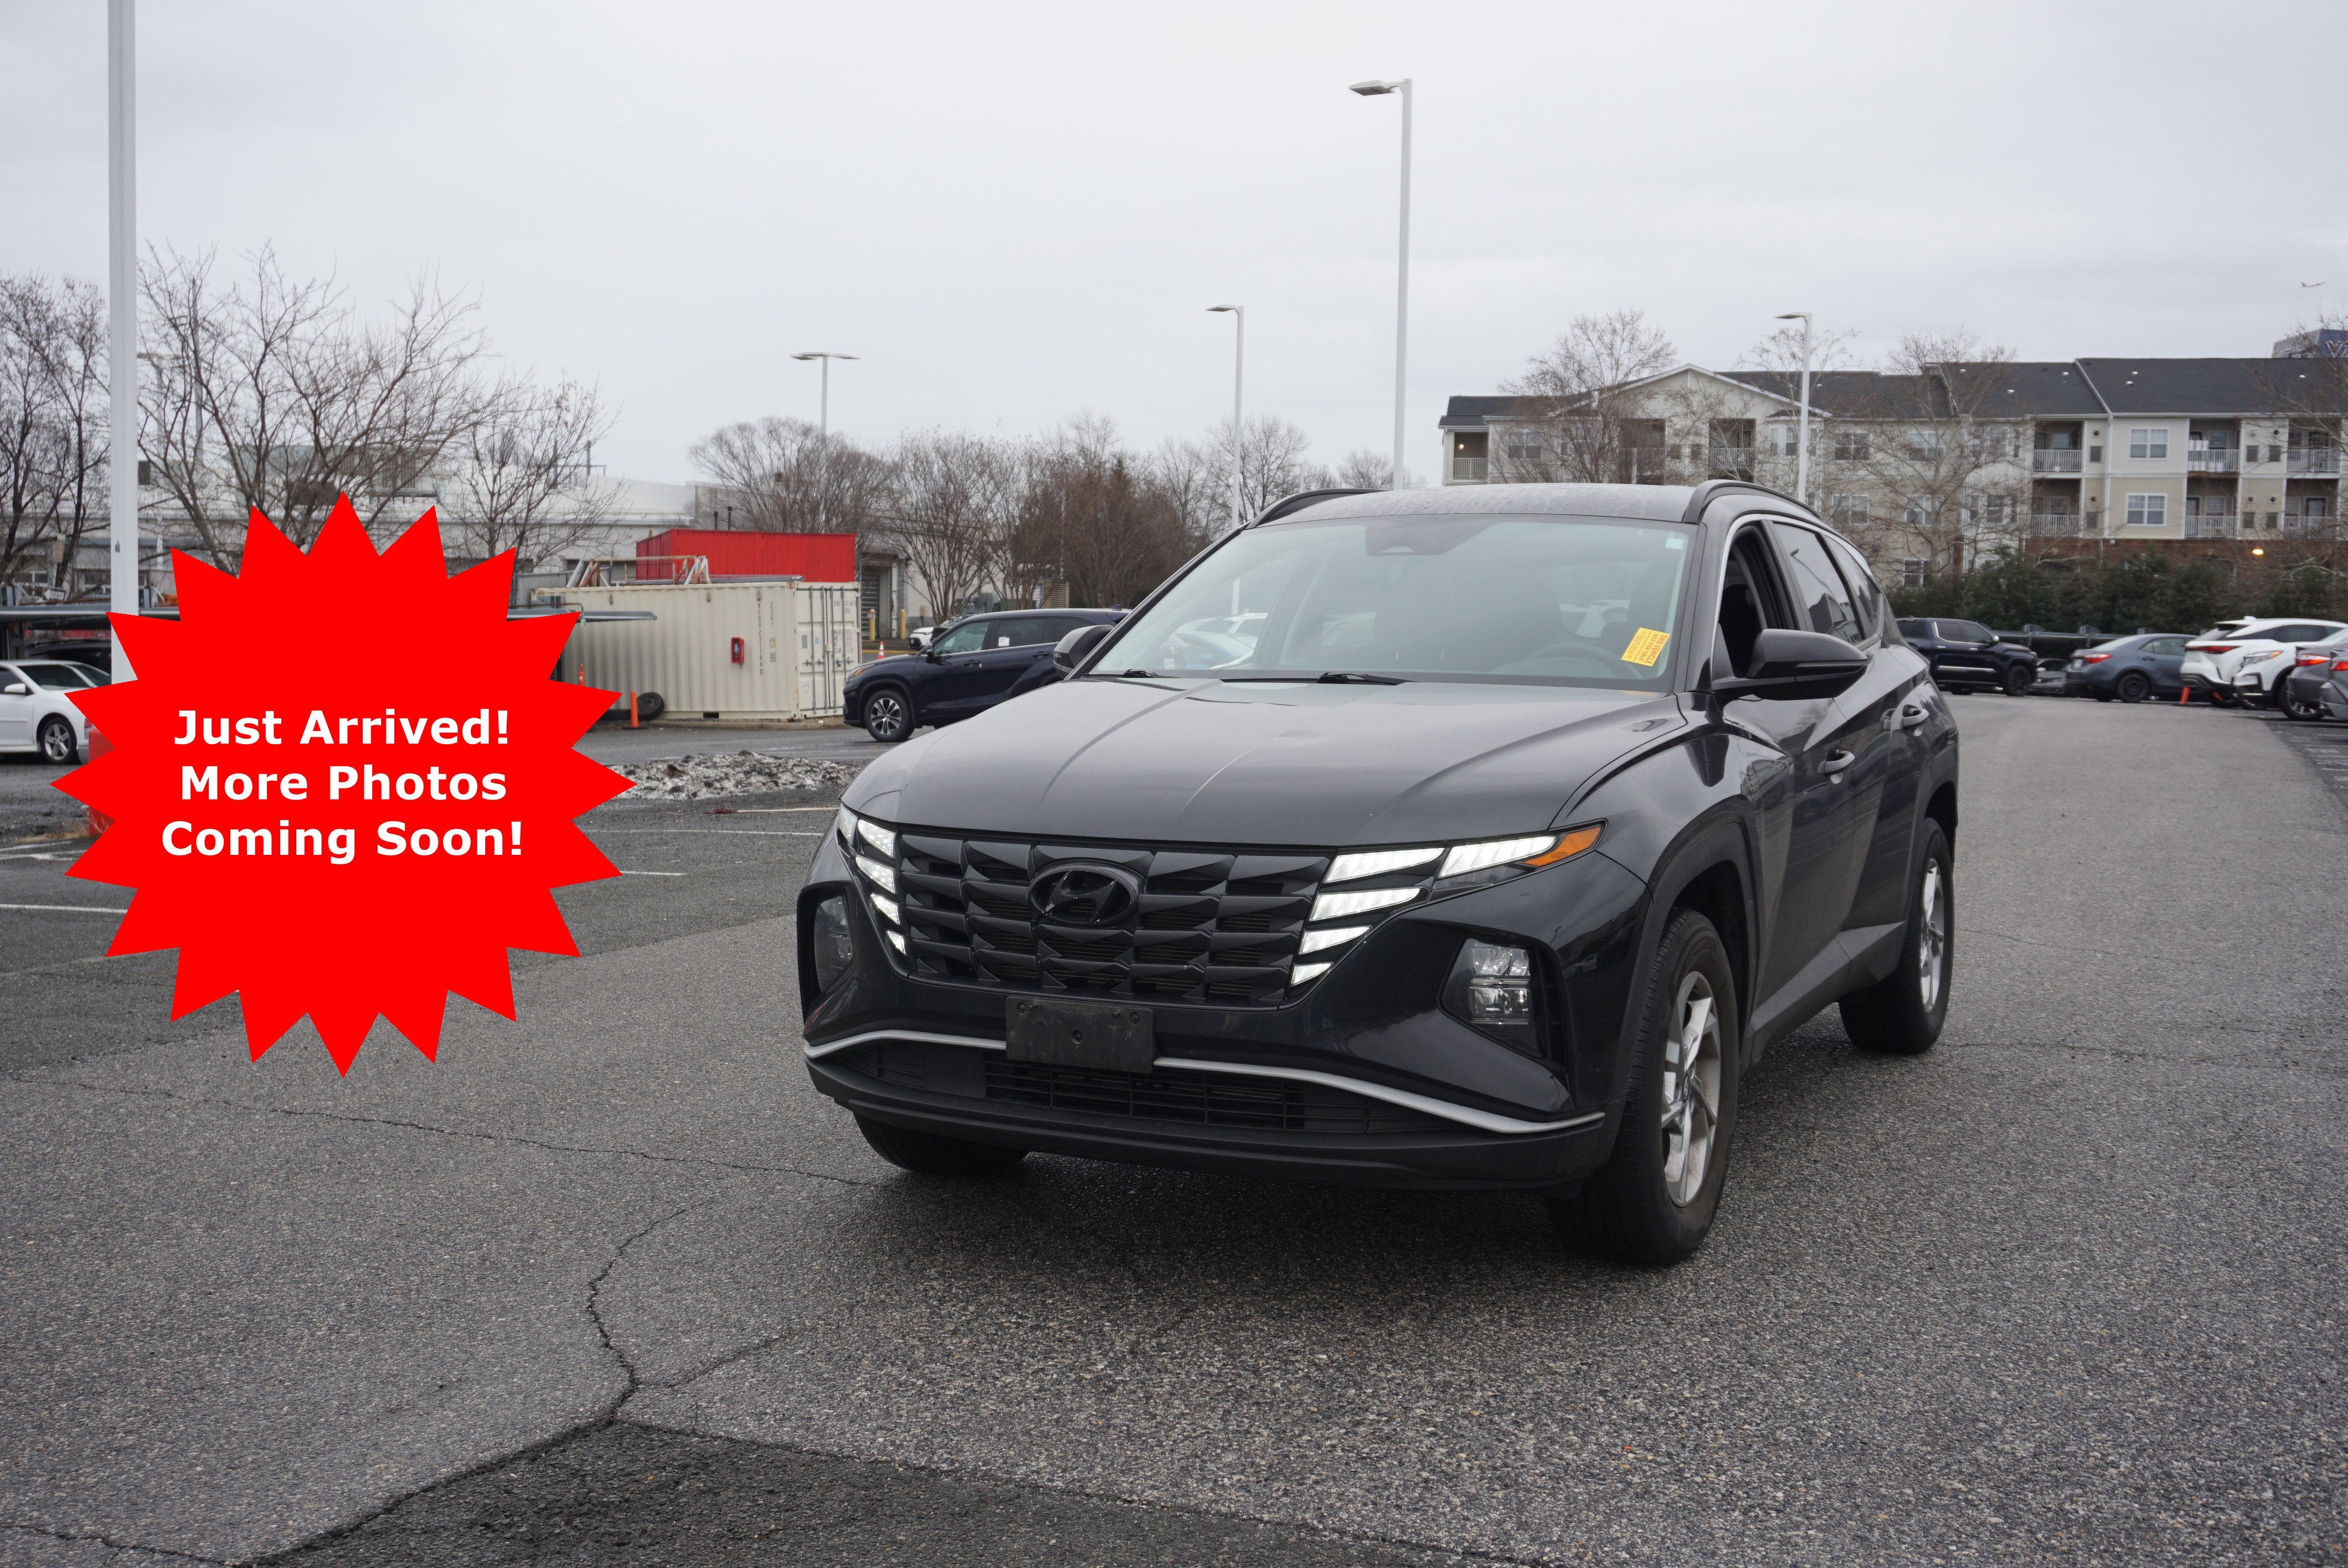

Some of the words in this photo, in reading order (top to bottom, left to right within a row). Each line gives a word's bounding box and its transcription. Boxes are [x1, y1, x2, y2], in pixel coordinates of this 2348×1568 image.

[1656, 635, 1667, 644] THIS
[1645, 642, 1654, 651] FOR
[1639, 651, 1649, 662] SALE
[1645, 645, 1661, 664] VEHICLE
